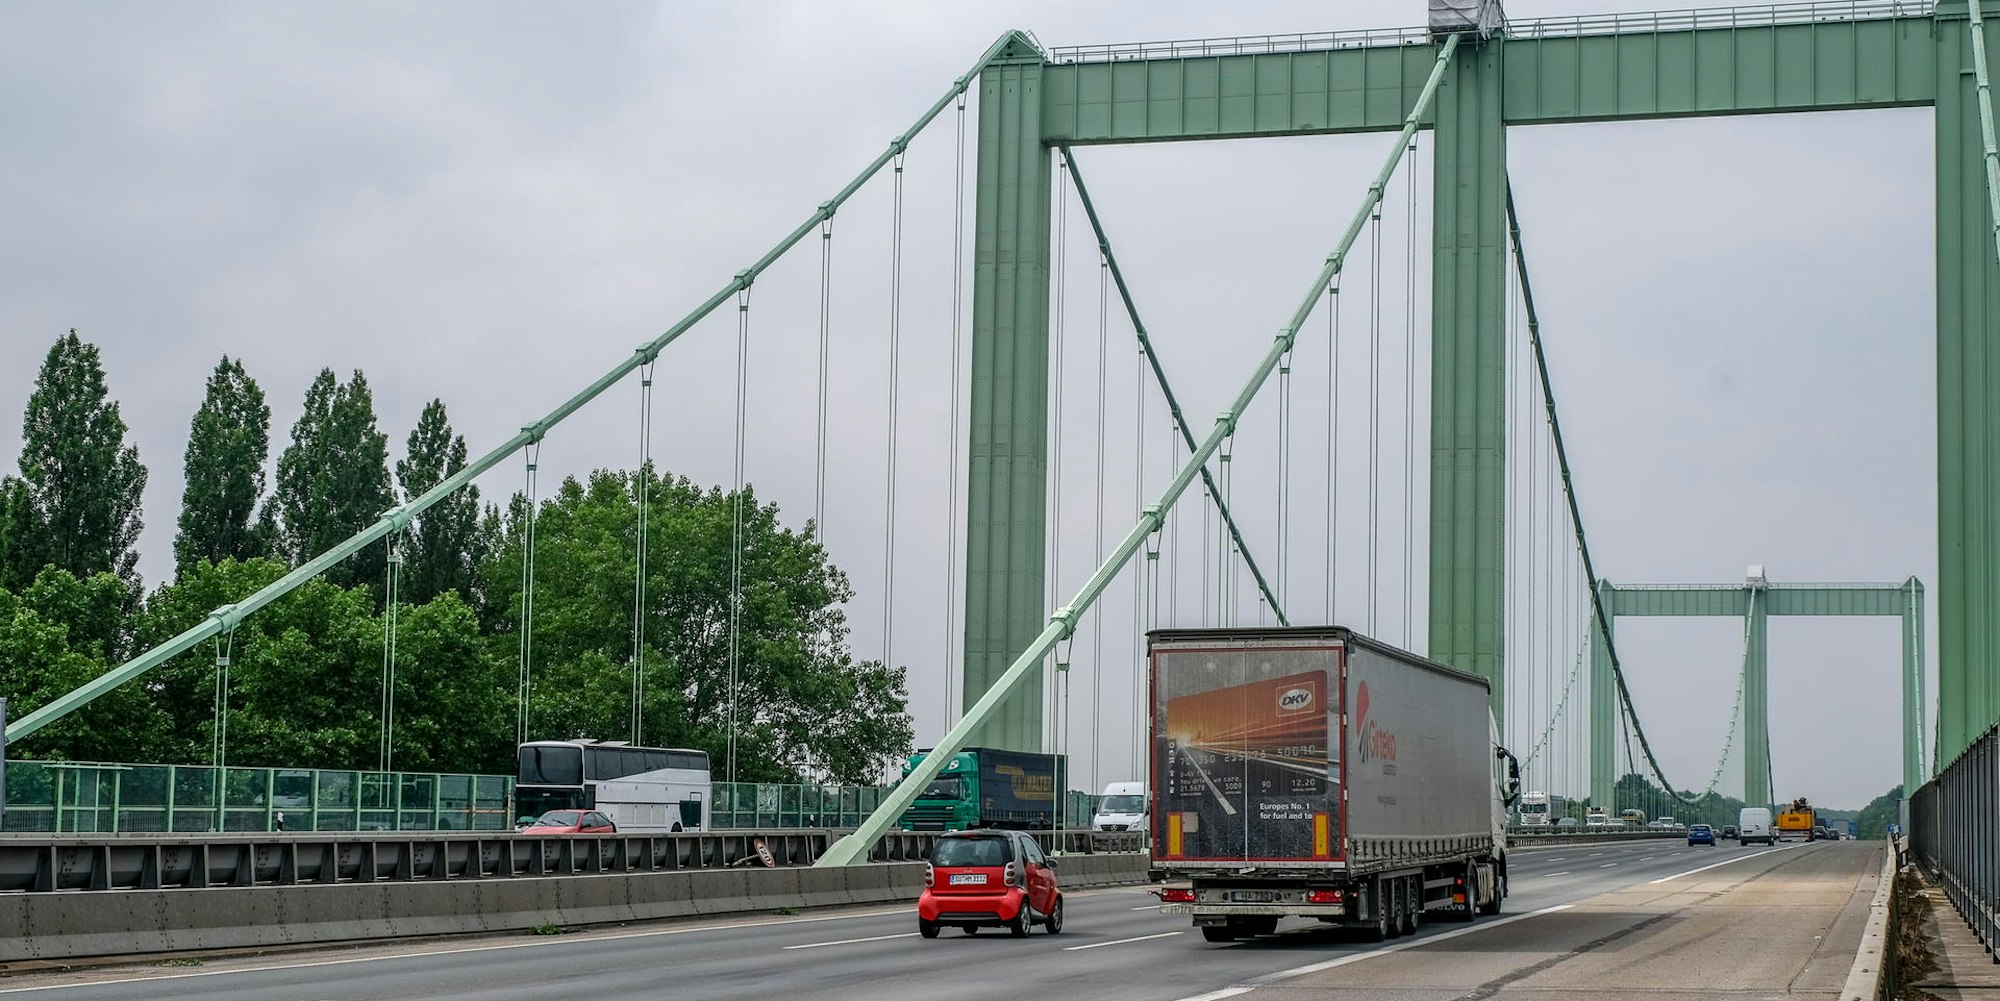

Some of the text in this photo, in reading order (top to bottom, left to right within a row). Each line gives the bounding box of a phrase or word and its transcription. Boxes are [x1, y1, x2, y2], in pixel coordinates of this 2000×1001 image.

[1282, 693, 1309, 706] DKV
[1261, 780, 1272, 788] 90
[1291, 778, 1316, 787] 12.20
[1259, 802, 1310, 811] Europes No. 1
[1259, 811, 1271, 820] for
[1272, 811, 1288, 820] fuel
[1288, 811, 1303, 820] and
